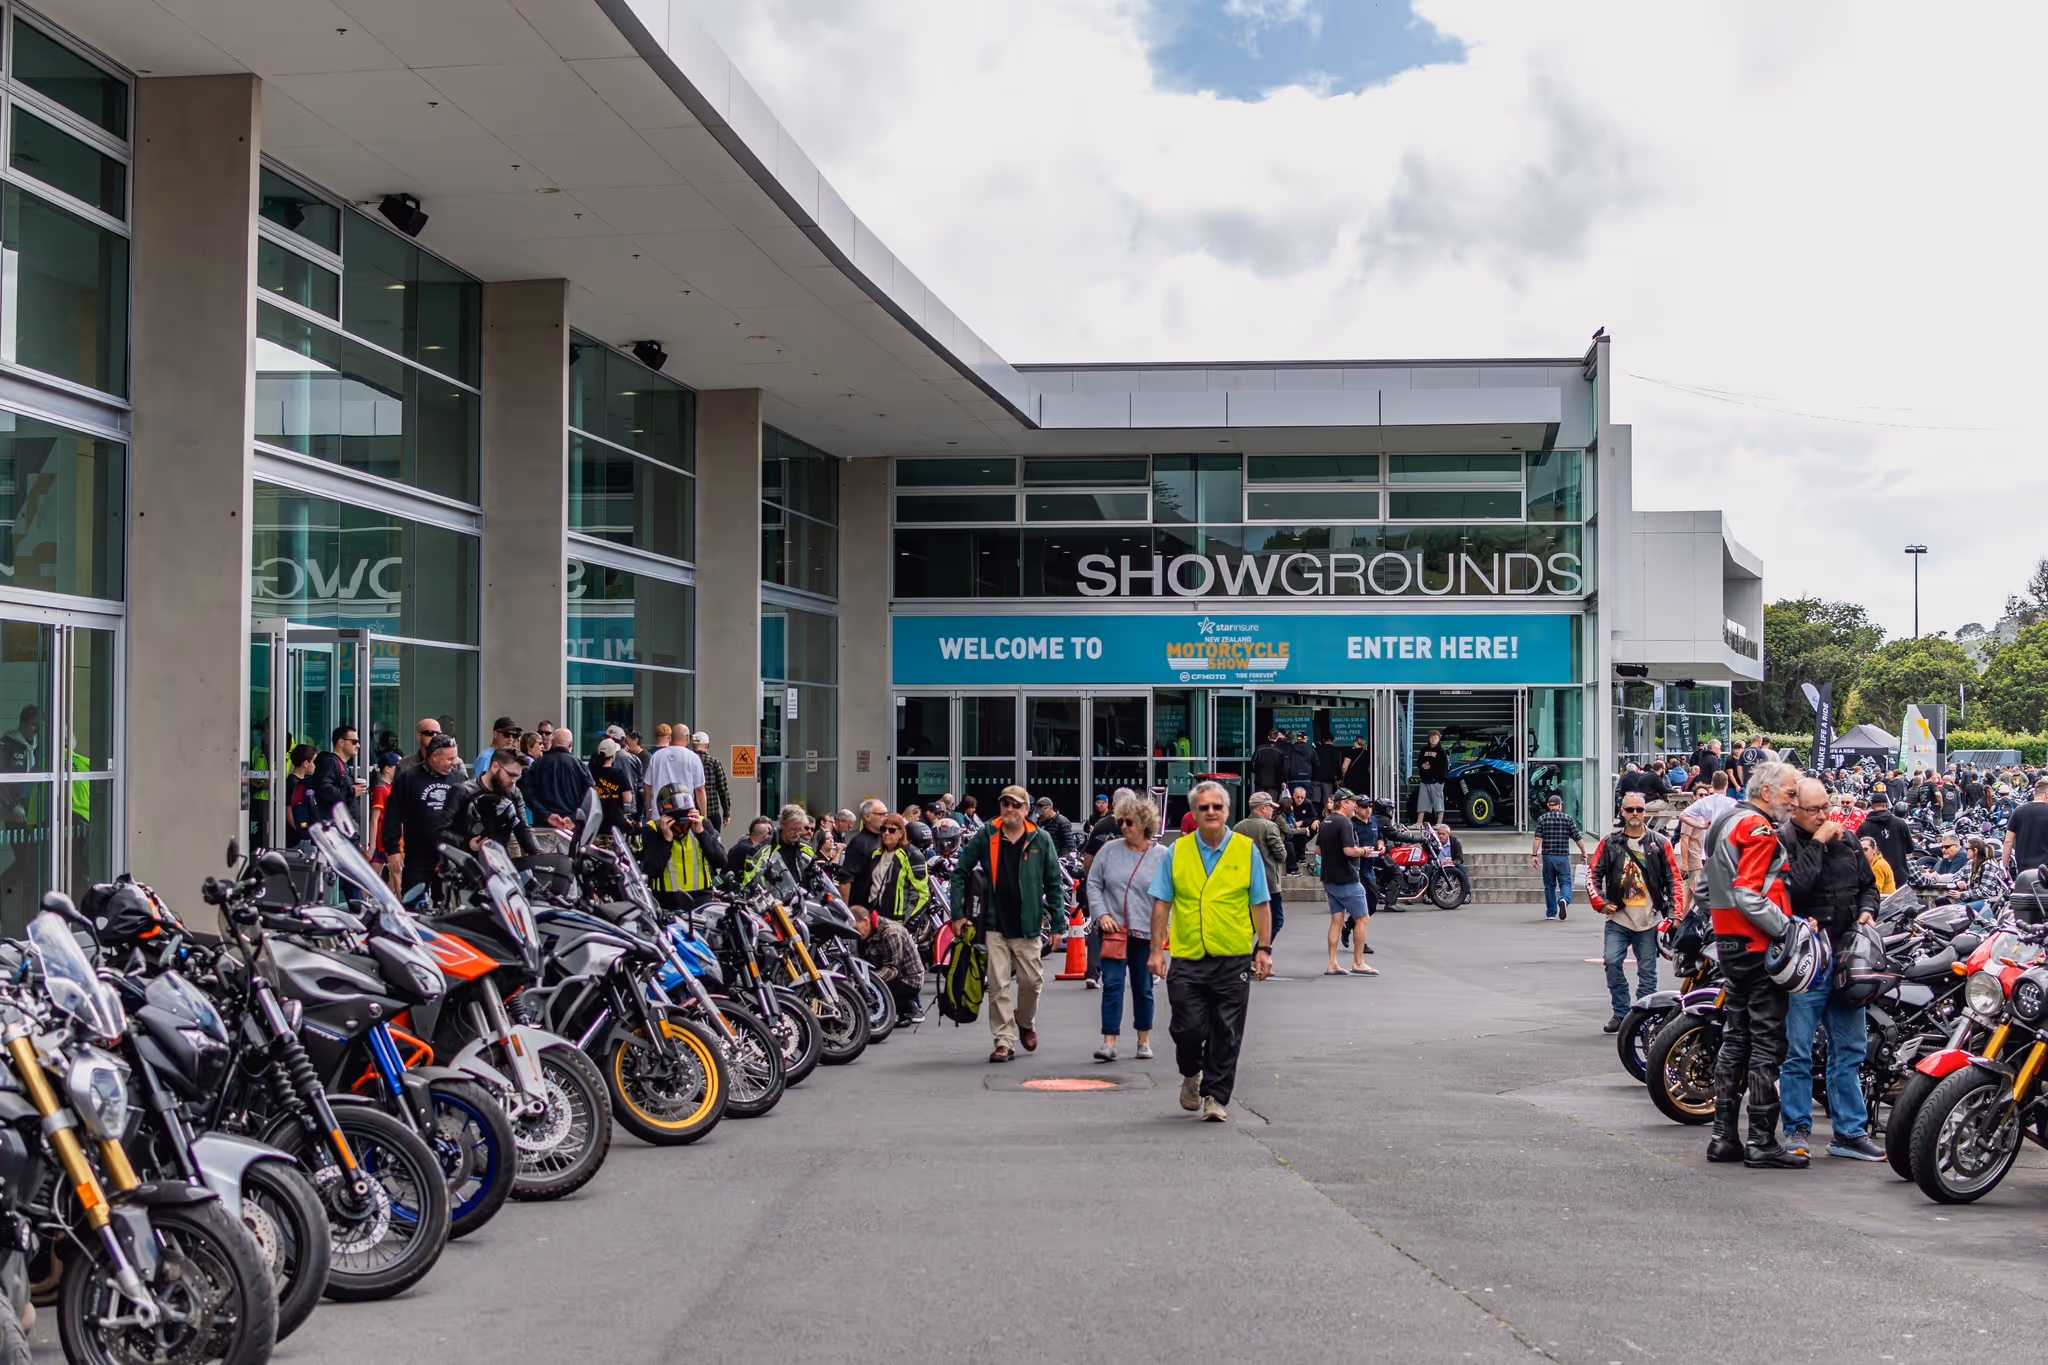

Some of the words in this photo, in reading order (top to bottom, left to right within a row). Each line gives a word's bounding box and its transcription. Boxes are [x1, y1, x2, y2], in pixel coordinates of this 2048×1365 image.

[1076, 552, 1582, 597] SHOWGROUNDS
[1215, 623, 1259, 632] starinsure
[939, 637, 1064, 660] WELCOME
[1071, 637, 1103, 660] TO
[1167, 642, 1290, 658] MOTORCYCLE
[1347, 636, 1433, 659] ENTER
[1440, 636, 1518, 659] HERE!
[1207, 658, 1249, 670] SHOW
[1820, 728, 1828, 746] LIFE
[1816, 746, 1827, 771] MAKE
[923, 771, 946, 780] Rotary
